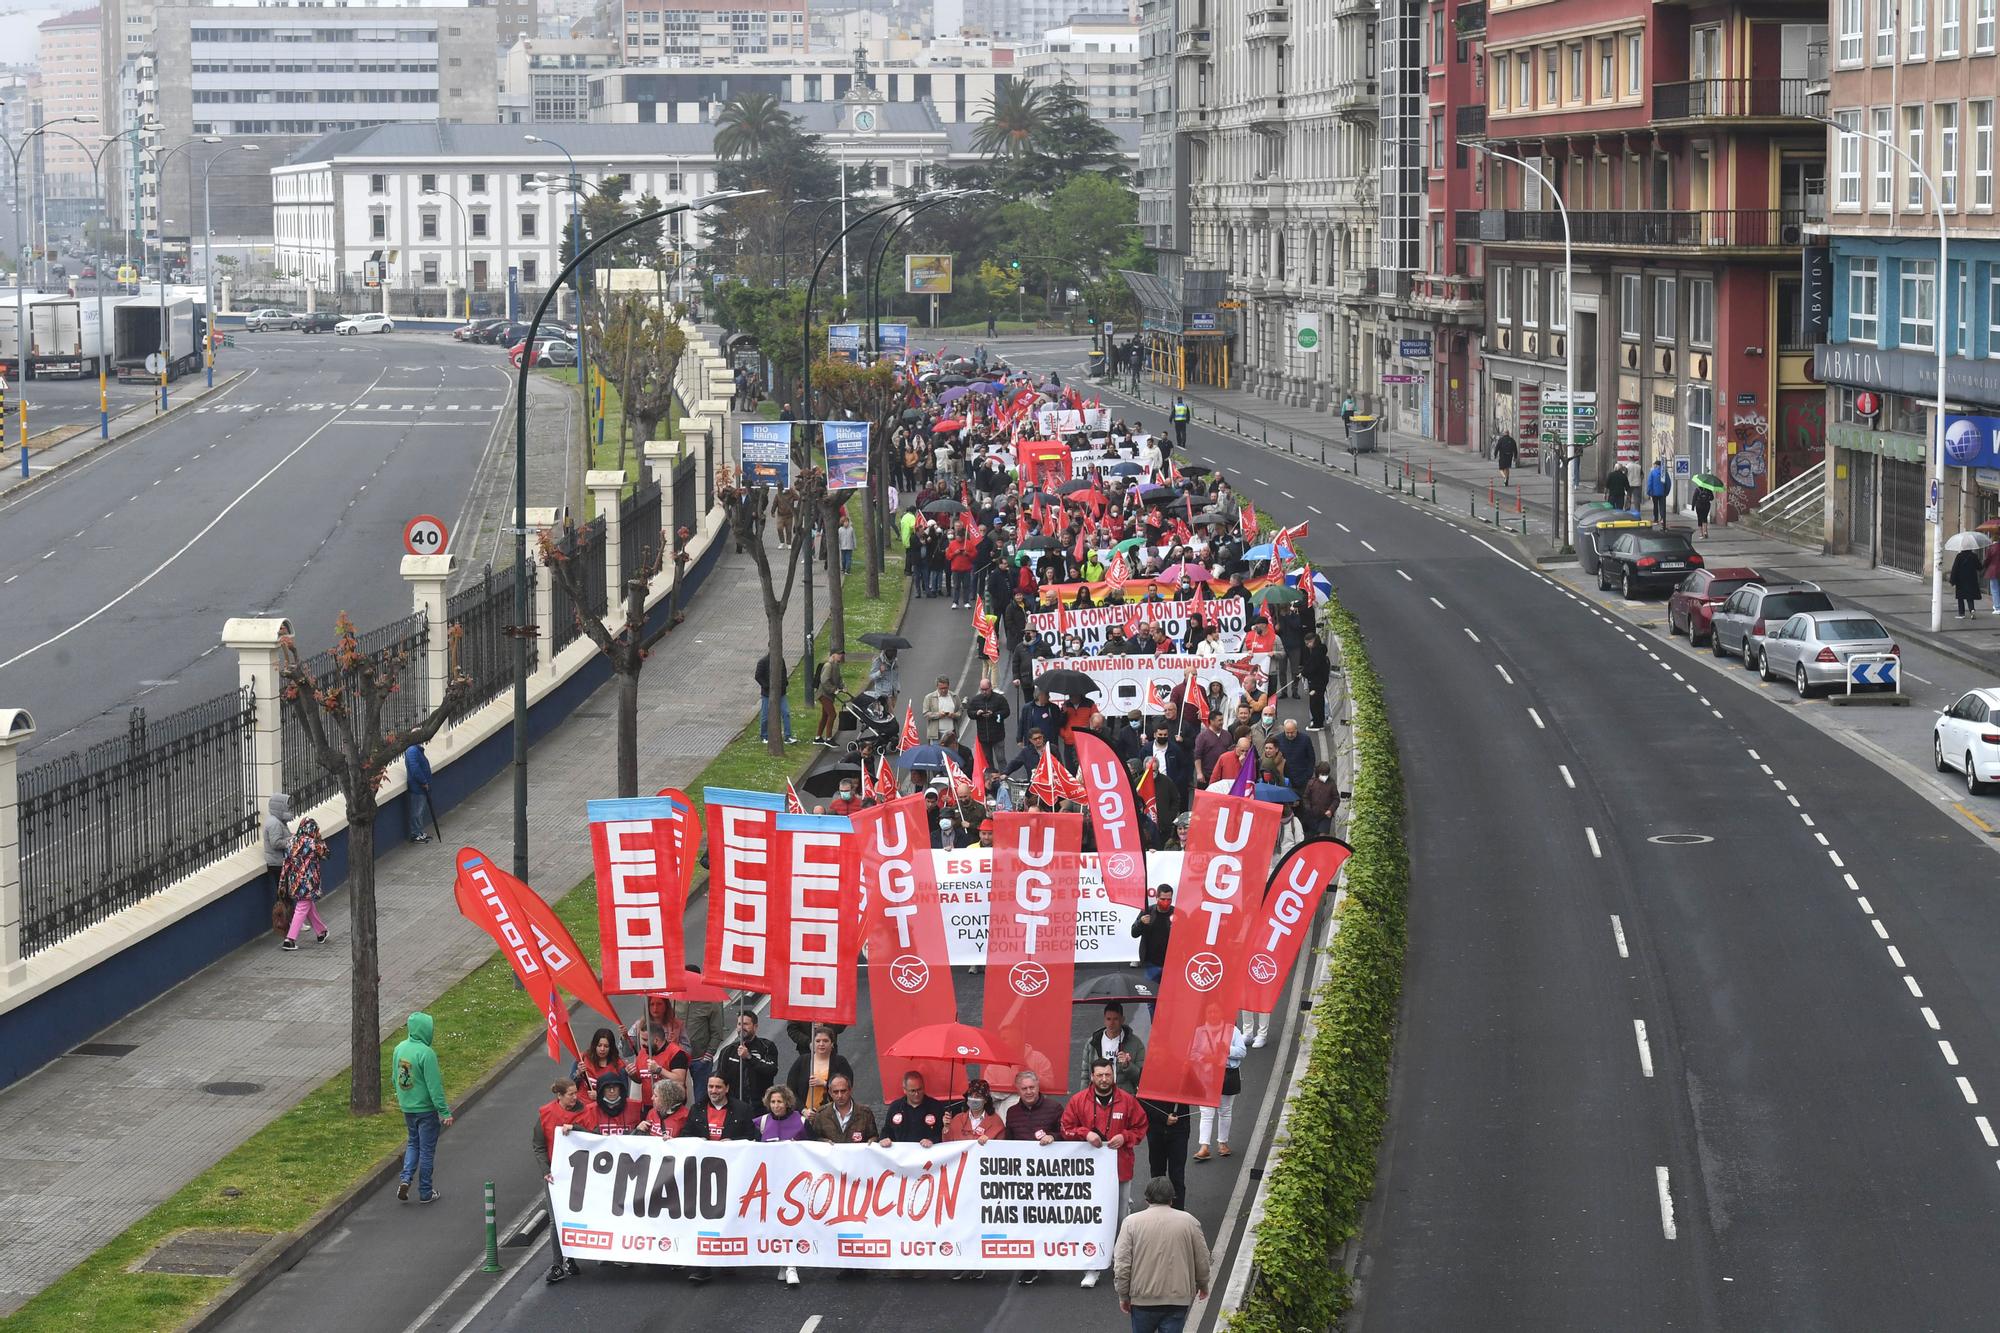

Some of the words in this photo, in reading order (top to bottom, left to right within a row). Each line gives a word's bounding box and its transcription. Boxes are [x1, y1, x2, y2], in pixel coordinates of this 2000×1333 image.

[412, 530, 438, 545] 40
[1071, 657, 1134, 672] CONVENIO
[1138, 658, 1154, 669] PA
[946, 859, 973, 875] ES
[1201, 807, 1254, 946] UGT
[876, 811, 918, 948] UGT
[936, 880, 983, 891] DEFENSA
[720, 806, 767, 977] CCOO
[964, 892, 983, 903] EL
[1015, 826, 1056, 955] UGT
[606, 820, 667, 991] CCOO
[1267, 857, 1319, 952] UGT
[472, 868, 540, 975] CCOO
[788, 832, 841, 1008] CCOO
[975, 942, 984, 953] Y
[980, 1157, 1021, 1177] SUBIR
[1026, 1158, 1094, 1177] SALARIOS
[612, 1153, 728, 1220] MAIO
[738, 1161, 771, 1223] A
[777, 1151, 968, 1228] SOLUCIÓN
[980, 1181, 1034, 1200] CONTER
[1038, 1181, 1092, 1201] PREZOS
[981, 1201, 1018, 1224] MÁIS
[1023, 1205, 1102, 1225] IGUALDADE
[564, 1231, 611, 1247] CCOO
[622, 1235, 656, 1250] UGT
[700, 1240, 745, 1253] CCOO
[757, 1239, 793, 1254] UGT
[841, 1242, 888, 1255] CCOO
[901, 1241, 936, 1256] UGT
[985, 1243, 1032, 1256] CCOO
[1043, 1241, 1079, 1257] UGT
